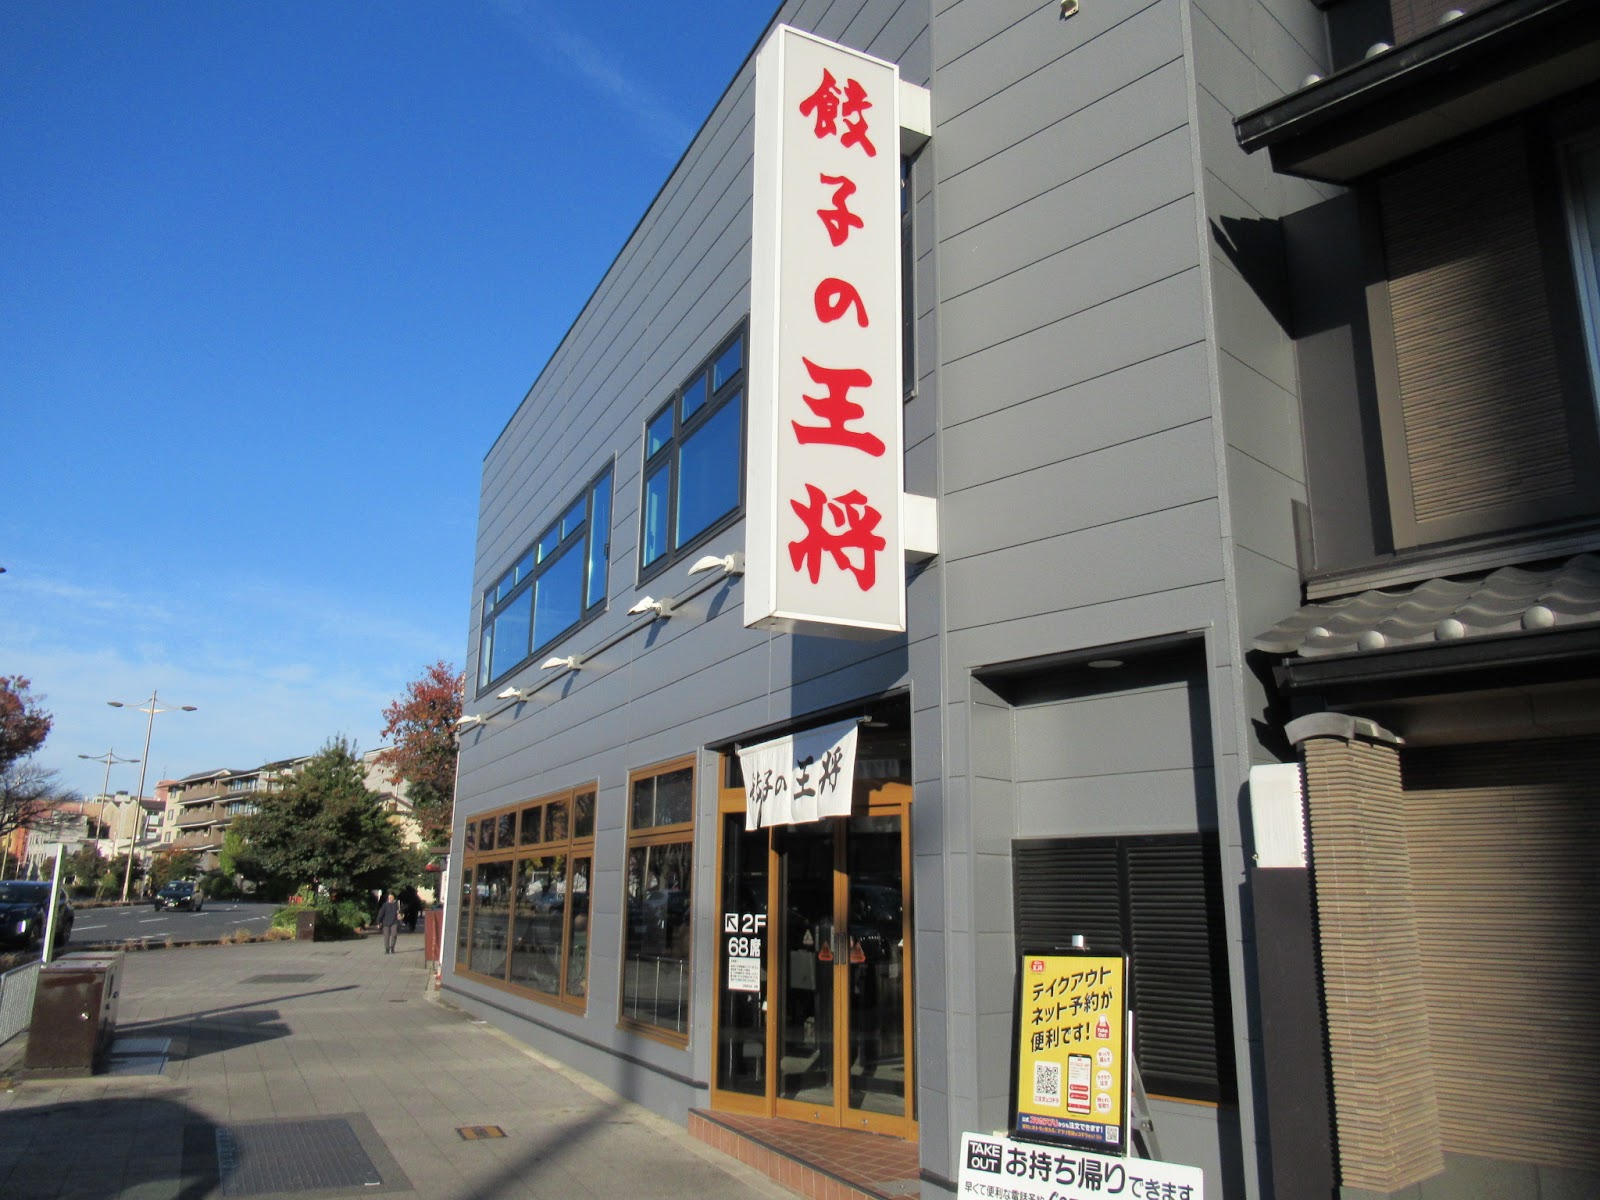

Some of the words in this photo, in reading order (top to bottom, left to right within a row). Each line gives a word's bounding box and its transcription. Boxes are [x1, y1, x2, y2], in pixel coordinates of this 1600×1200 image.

[789, 67, 886, 592] 餃子の王将
[742, 913, 767, 934] 2F
[728, 936, 761, 957] 68席
[1033, 966, 1111, 1001] テイクアウト
[1031, 986, 1113, 1026] ネット予約が
[970, 1141, 1001, 1157] TAKE
[971, 1158, 998, 1171] OUT
